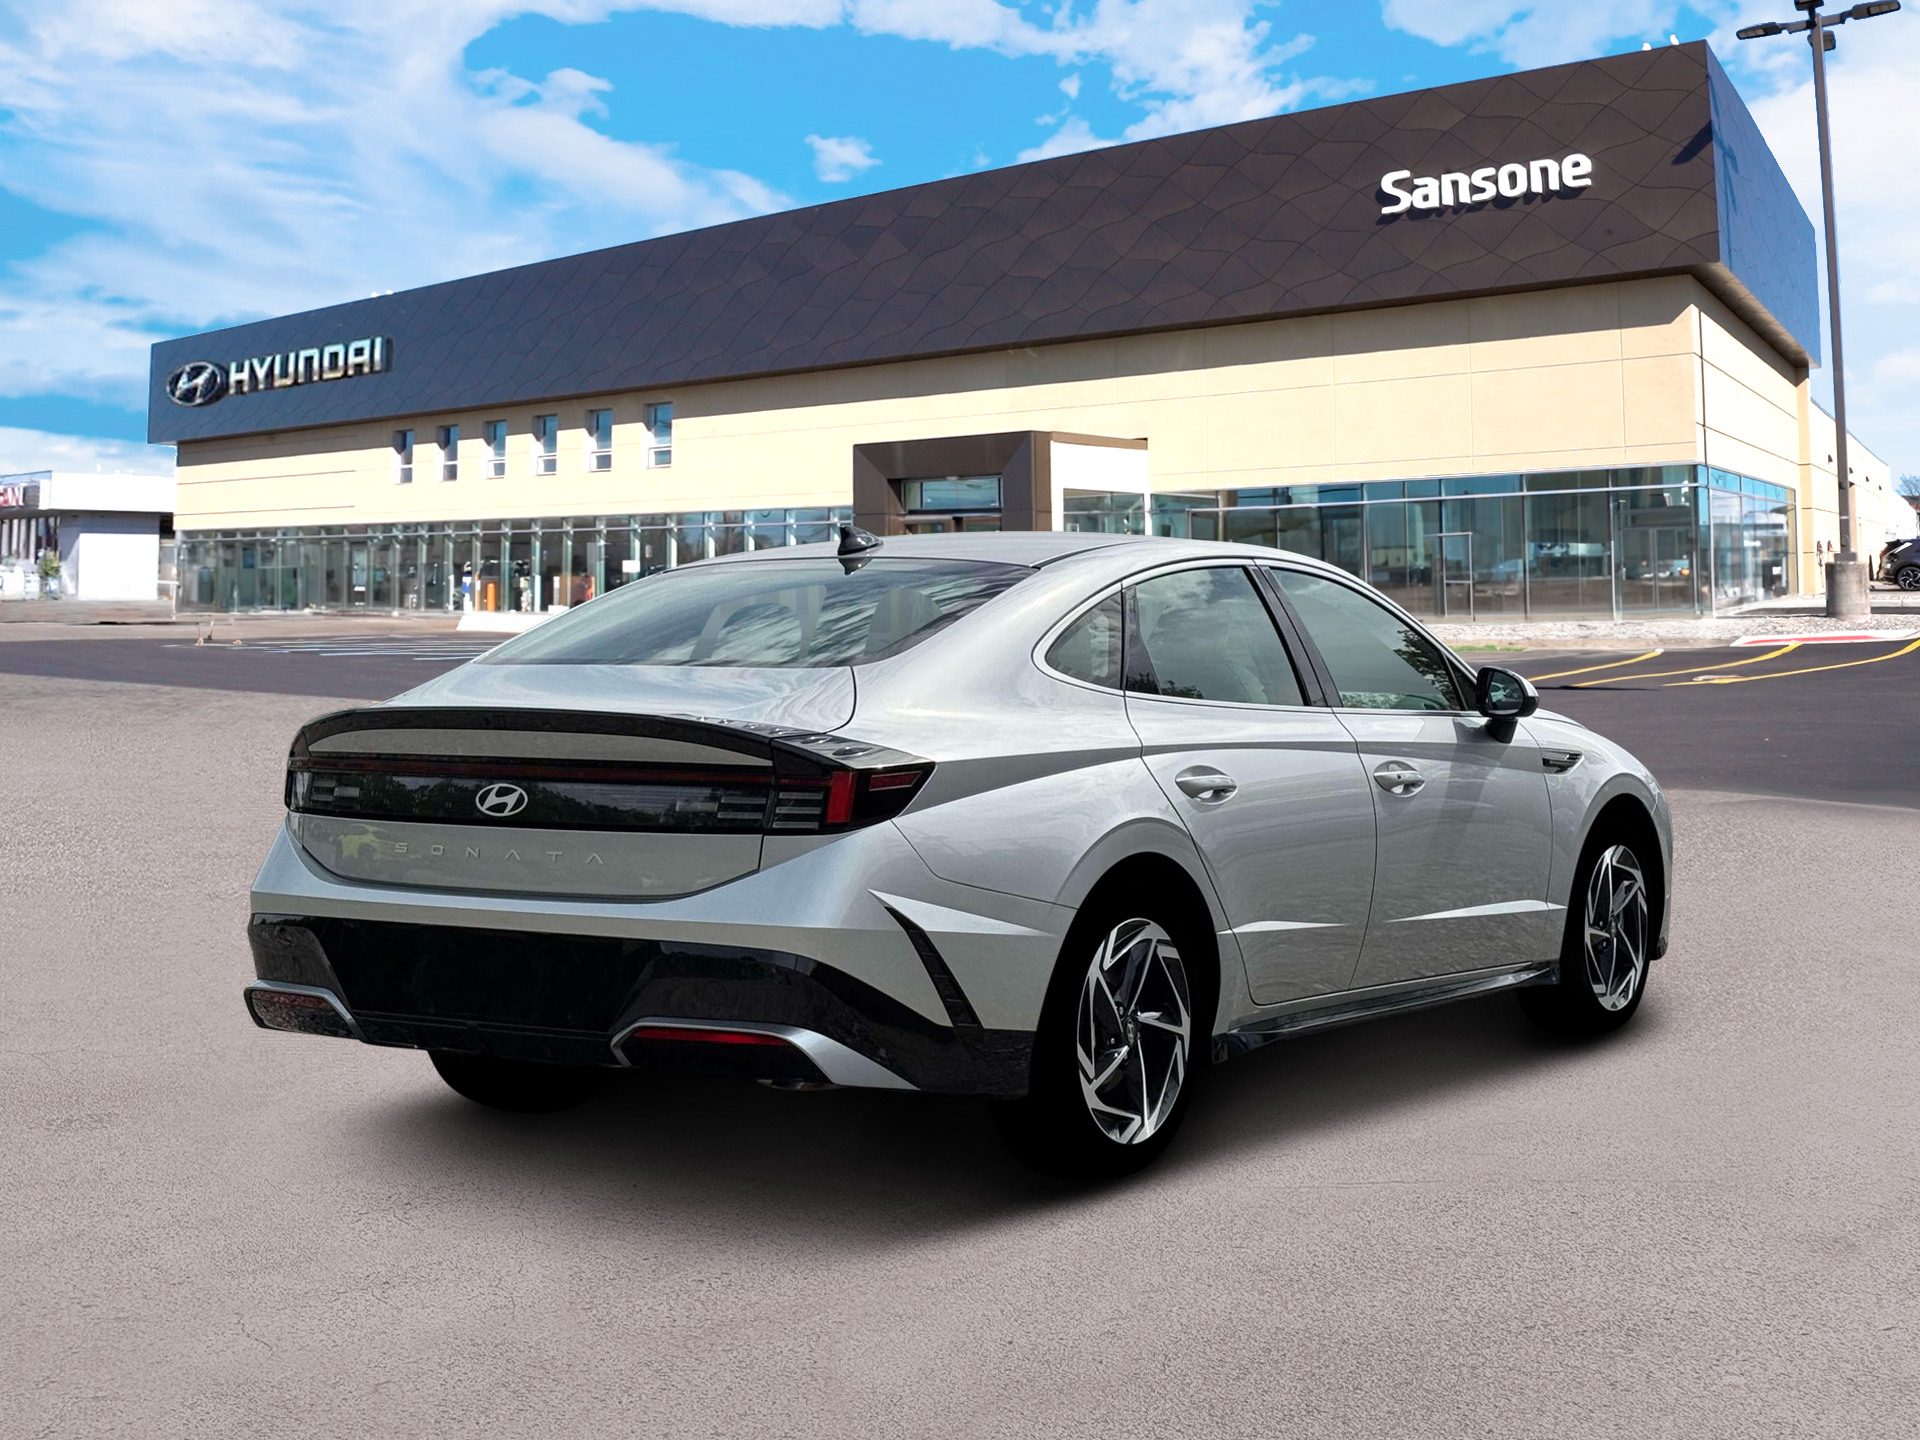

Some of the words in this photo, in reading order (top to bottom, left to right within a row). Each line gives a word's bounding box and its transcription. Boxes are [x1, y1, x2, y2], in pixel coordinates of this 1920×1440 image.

[1380, 153, 1592, 214] Sansone
[228, 337, 384, 395] HYUNDAI
[395, 842, 604, 865] SONATA
